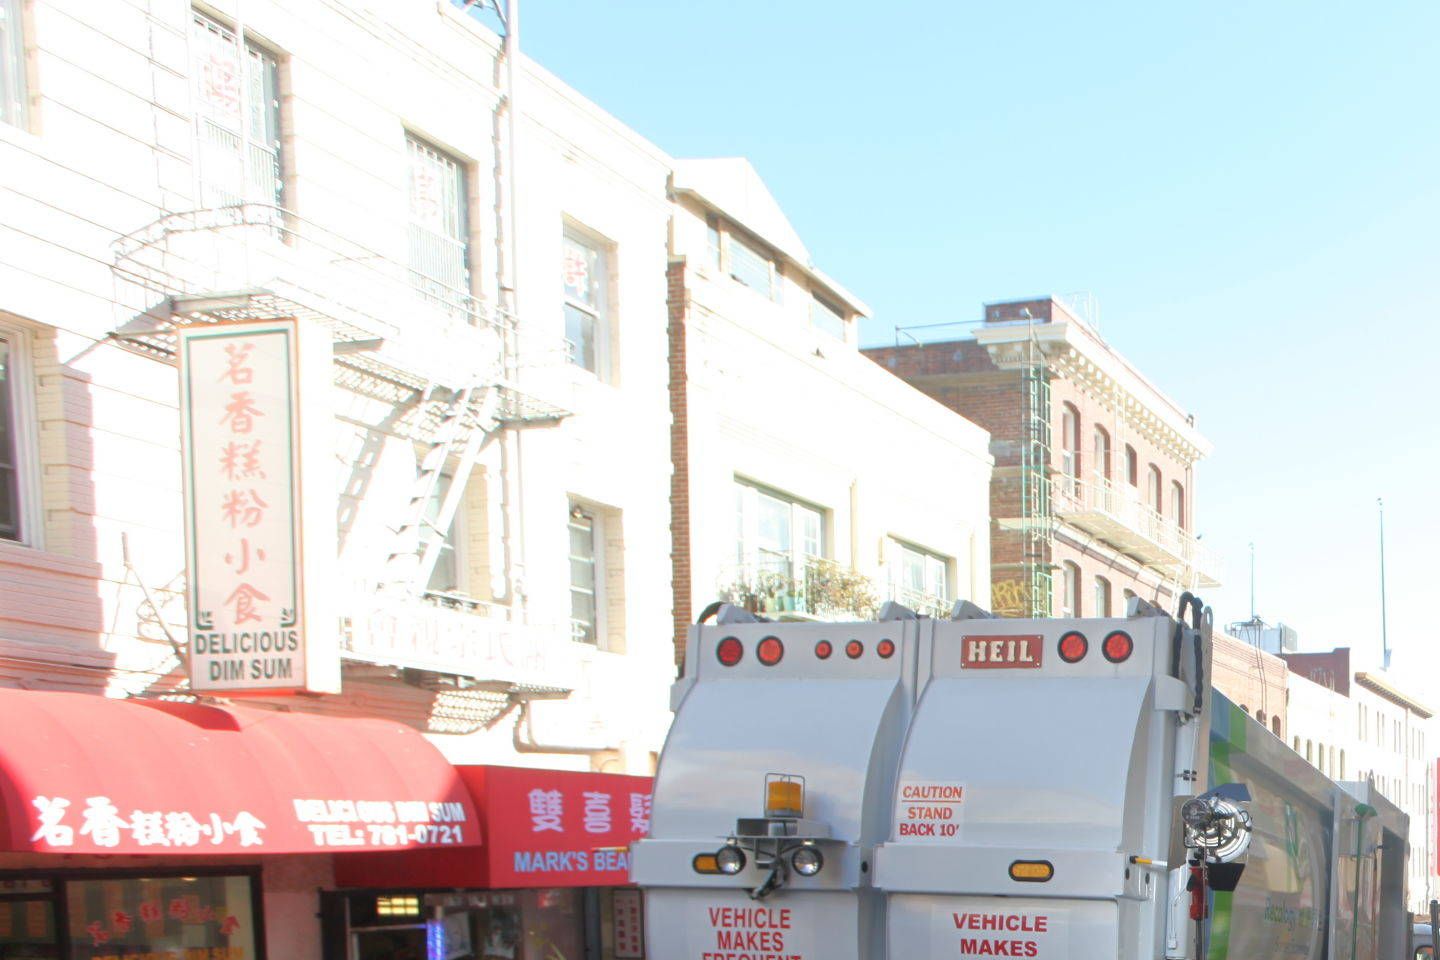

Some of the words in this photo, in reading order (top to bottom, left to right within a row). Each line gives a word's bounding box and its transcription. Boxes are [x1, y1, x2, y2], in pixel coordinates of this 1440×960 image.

[217, 342, 270, 625] 茗香糕粉小食
[195, 631, 298, 655] DELICIOUS
[968, 640, 1034, 662] HEIL
[209, 660, 244, 682] DIM
[251, 658, 293, 680] SUM
[902, 785, 963, 798] CAUTION
[429, 802, 467, 822] SUM
[907, 806, 953, 820] STAND
[307, 824, 365, 846] TEL:
[899, 823, 936, 836] BACK
[514, 851, 589, 873] MARK'S
[593, 850, 632, 871] BEA
[708, 907, 792, 929] VEHICLE
[952, 912, 1048, 933] VEHICLE
[717, 930, 785, 952] MAKES
[960, 938, 1038, 957] MAKES
